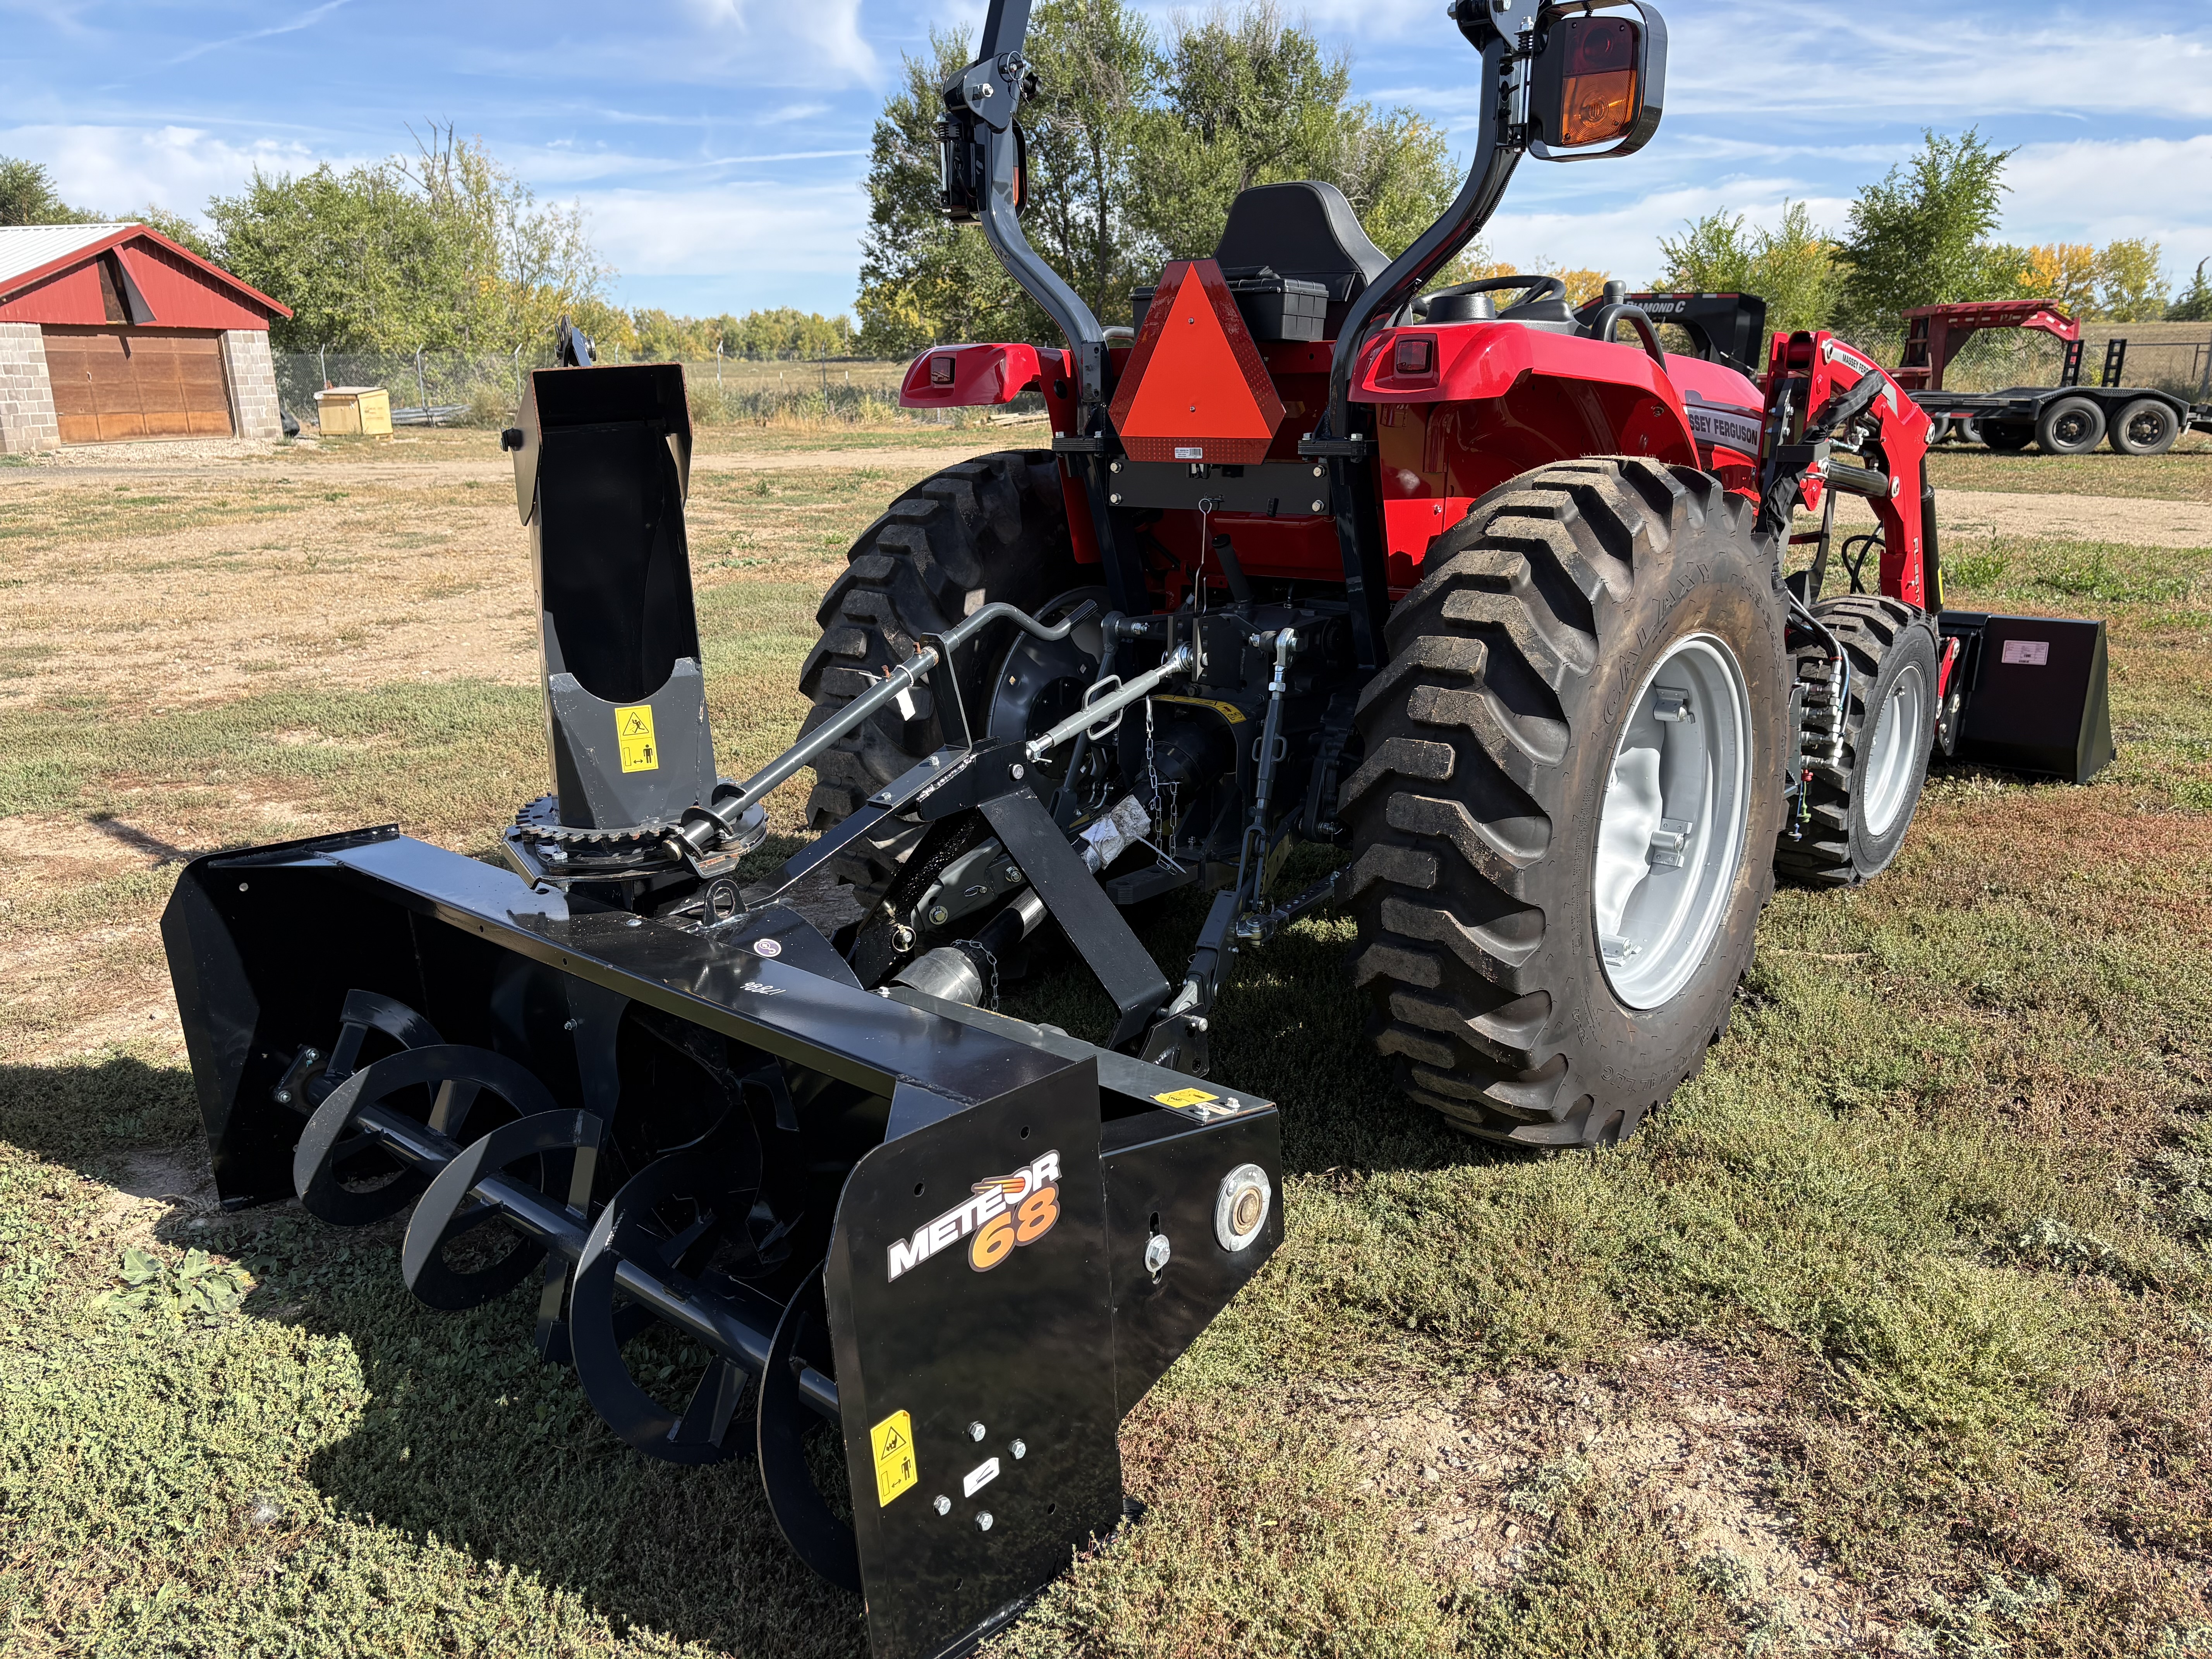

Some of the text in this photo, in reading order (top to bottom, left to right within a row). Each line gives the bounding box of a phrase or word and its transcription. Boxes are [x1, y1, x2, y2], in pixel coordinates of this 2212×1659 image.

[1675, 301, 1686, 313] C
[1999, 314, 2013, 322] PJ
[1843, 354, 1858, 369] MASSEY
[1688, 414, 1757, 446] SSEY FERGUSON
[1604, 560, 1715, 724] GALAXY
[1571, 1007, 1589, 1047] R-4
[1601, 1065, 1635, 1091] LUG
[890, 1153, 1059, 1279] METEOR
[972, 1187, 1057, 1268] 68
